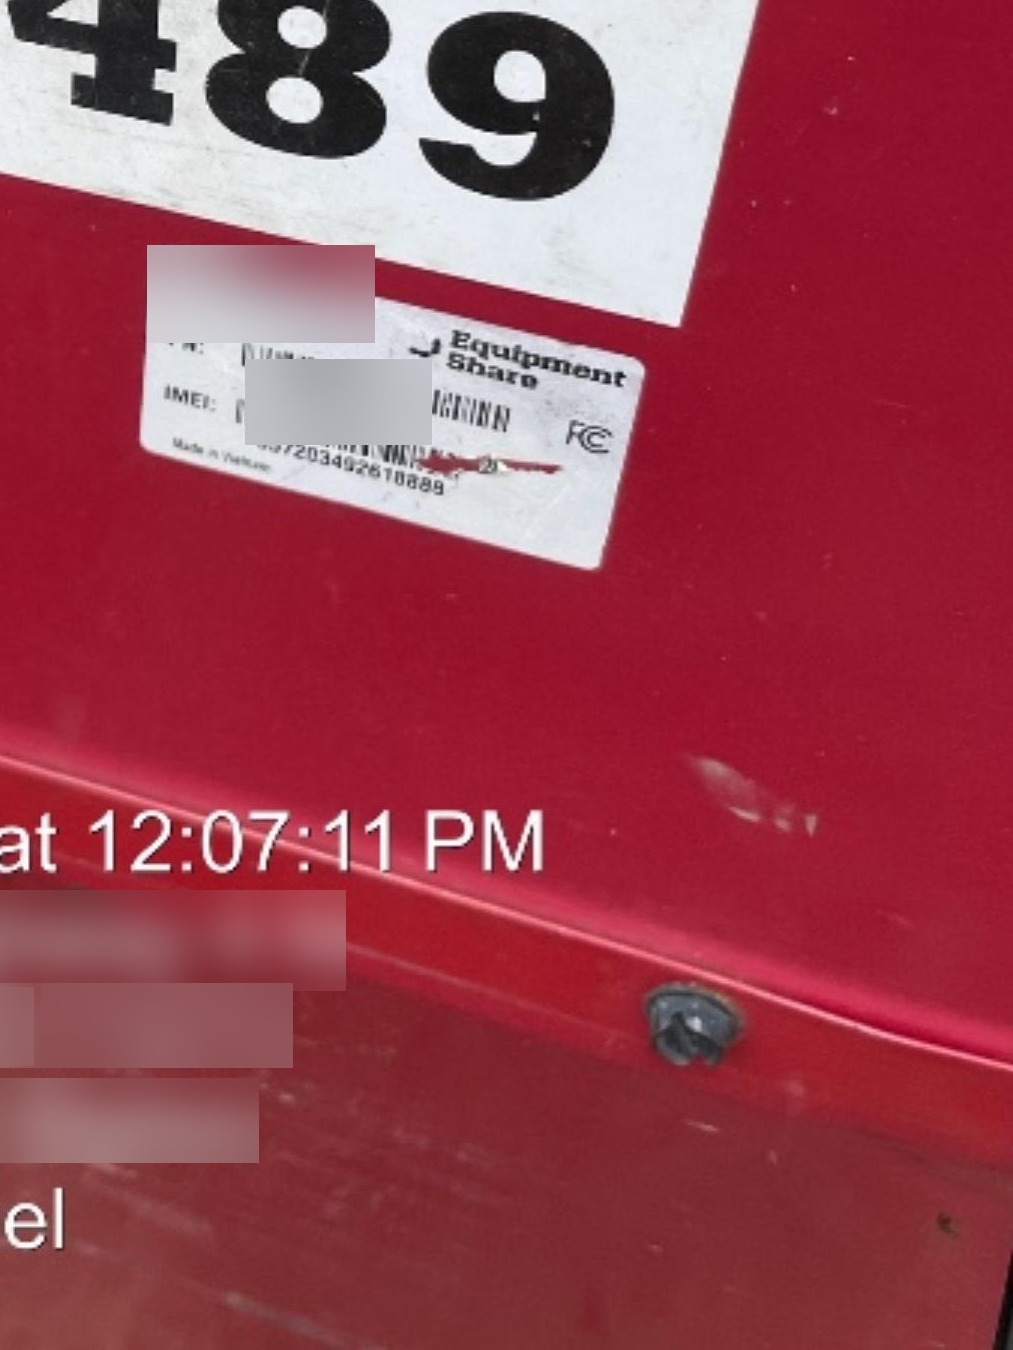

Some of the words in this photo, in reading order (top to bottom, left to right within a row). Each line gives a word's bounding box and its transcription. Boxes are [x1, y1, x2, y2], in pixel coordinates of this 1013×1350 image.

[446, 351, 539, 390] Share
[450, 329, 627, 388] Equipment
[164, 383, 216, 412] IMEI:
